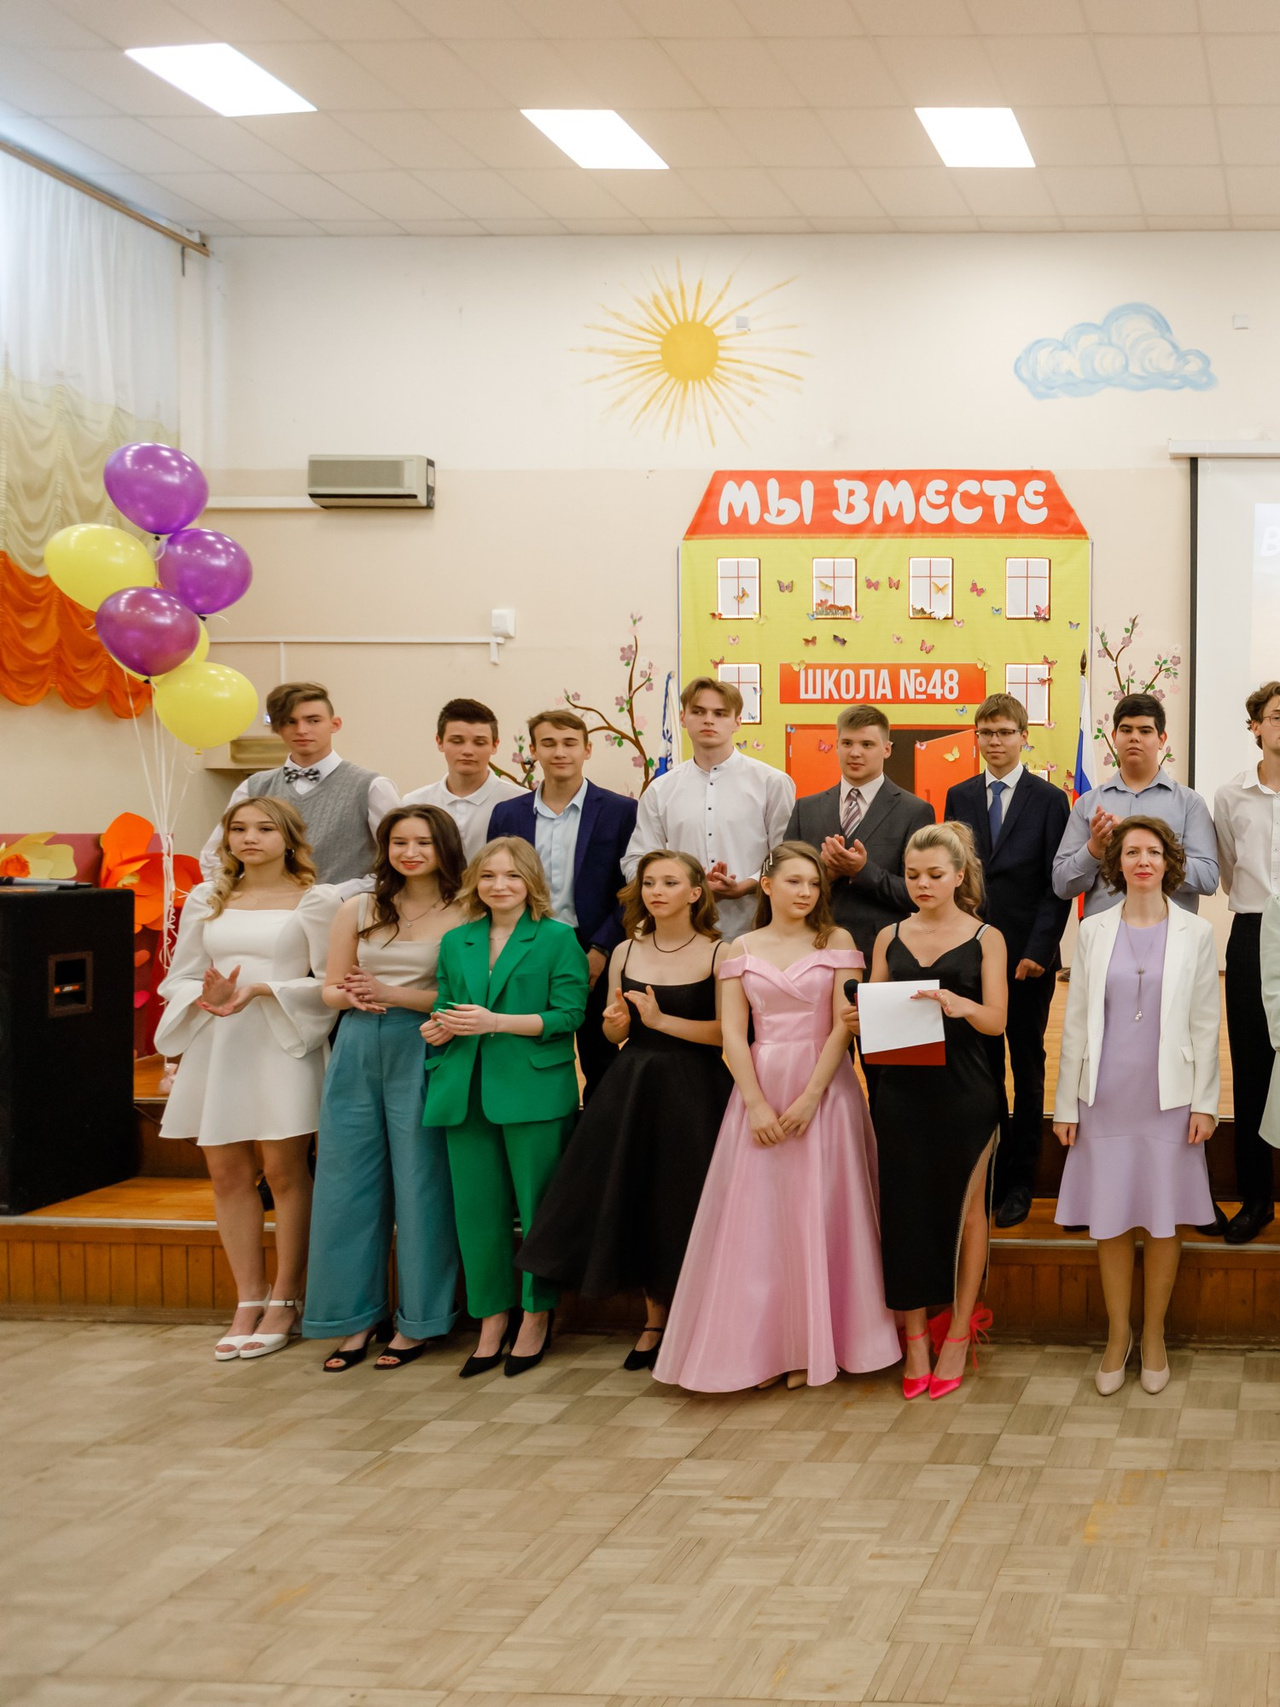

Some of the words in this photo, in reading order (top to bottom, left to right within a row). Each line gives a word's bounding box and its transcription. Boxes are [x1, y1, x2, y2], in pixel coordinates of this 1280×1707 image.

[718, 478, 814, 525] МЫ
[832, 478, 1048, 525] ВМЕСТЕ
[799, 668, 893, 700] ШКОЛА
[899, 668, 960, 700] №48
